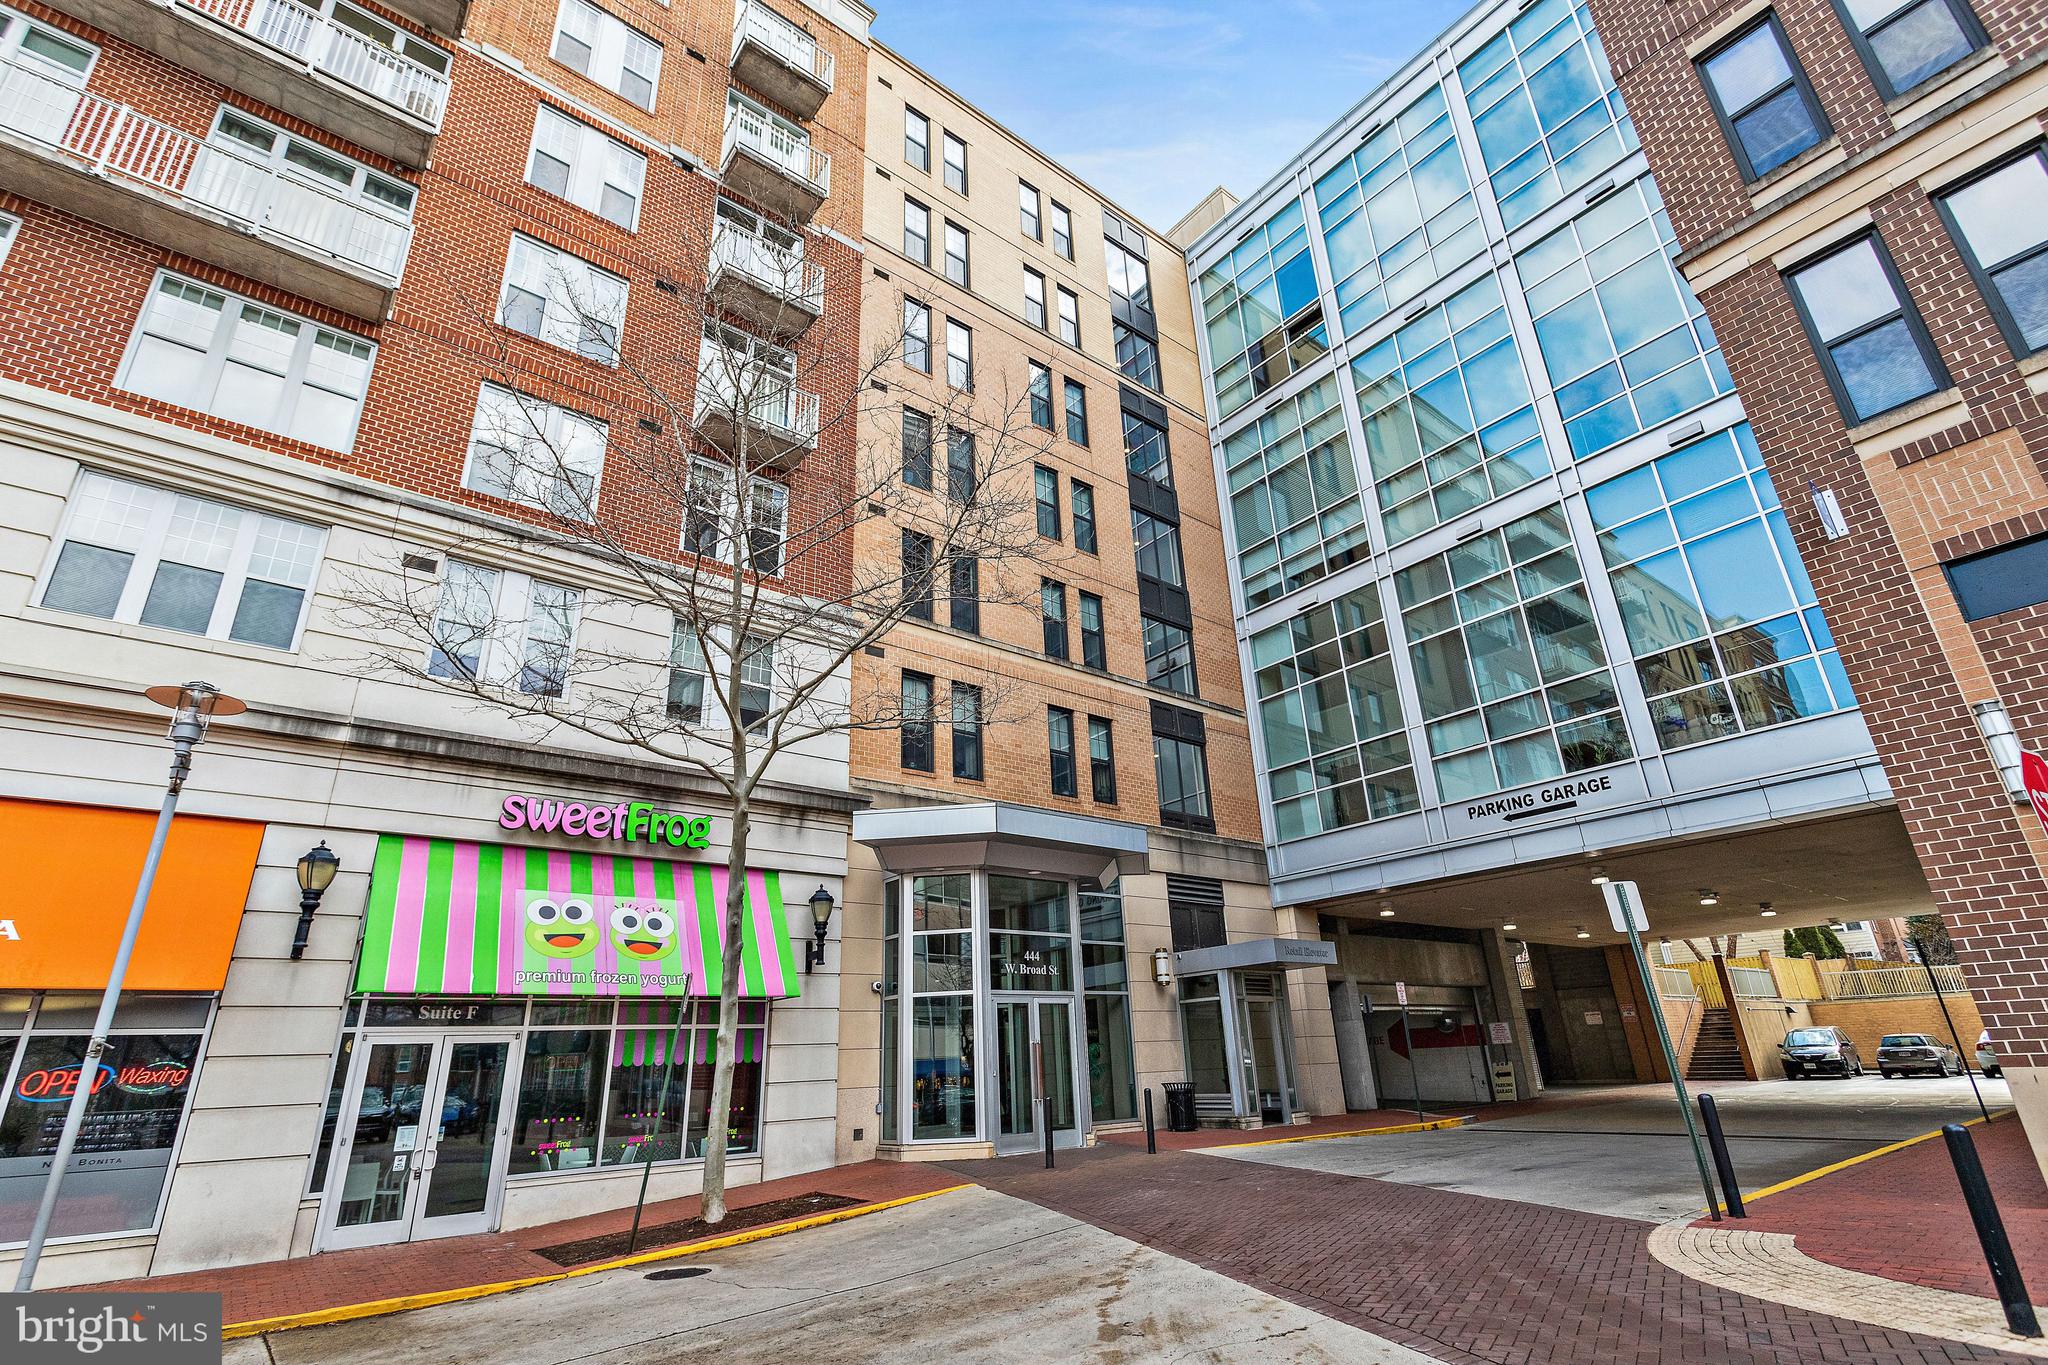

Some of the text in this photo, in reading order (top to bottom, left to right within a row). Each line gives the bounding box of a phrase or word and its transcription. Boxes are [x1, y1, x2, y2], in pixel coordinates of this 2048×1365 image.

[1467, 776, 1612, 820] PARKING GARAGE
[499, 795, 713, 850] sweetFrog
[1024, 950, 1040, 961] 444
[515, 969, 688, 987] premium frozen yogurt
[1005, 963, 1018, 974] W.
[1020, 964, 1047, 975] Broad
[419, 1005, 479, 1019] Suite F
[118, 1067, 188, 1087] Waxing
